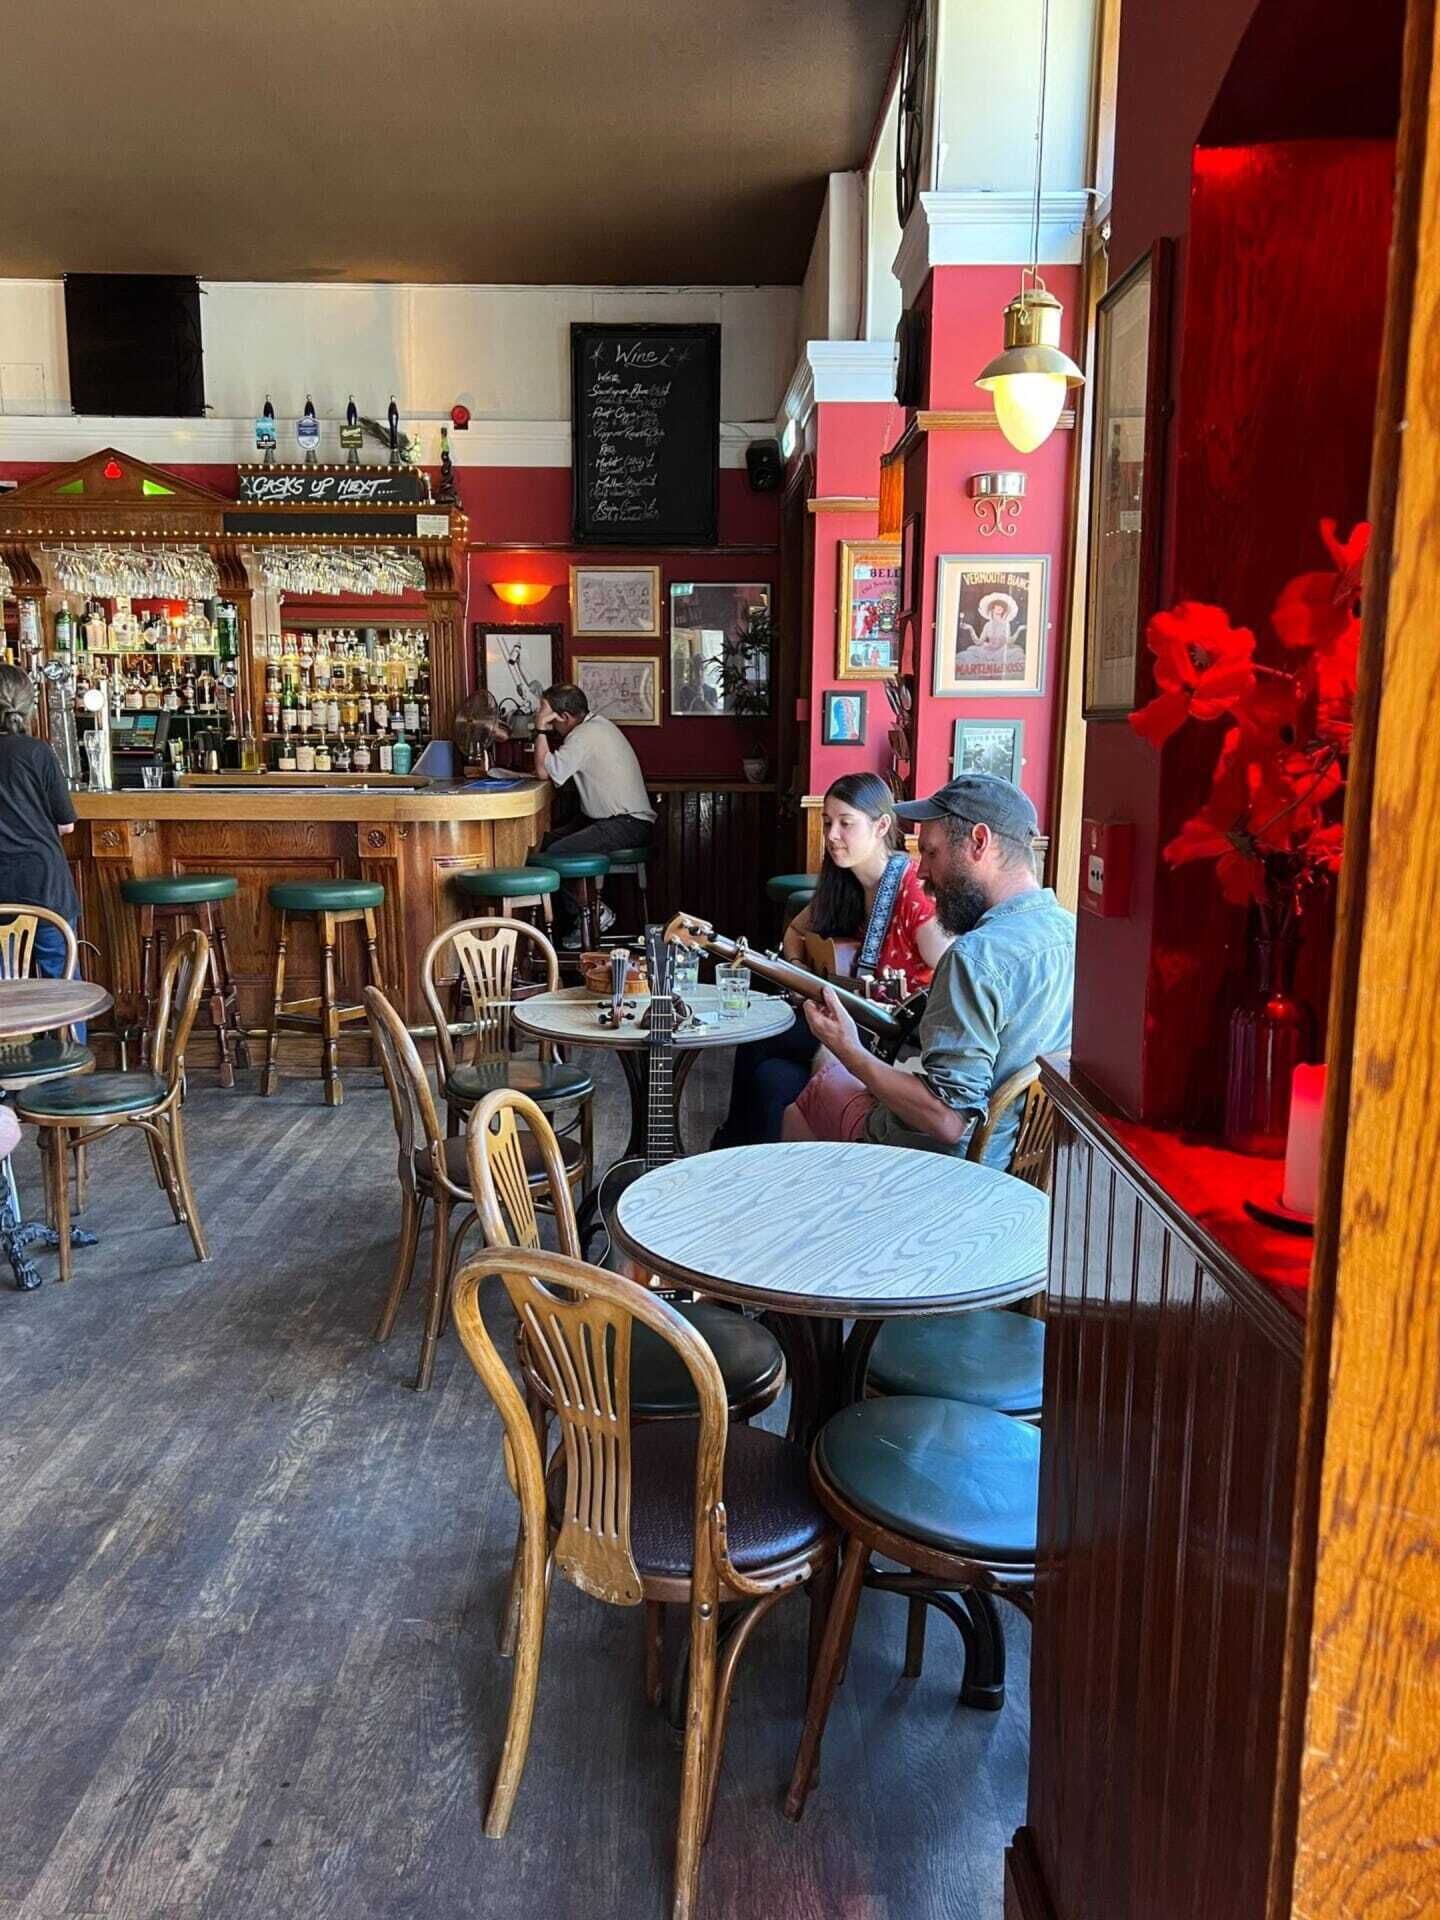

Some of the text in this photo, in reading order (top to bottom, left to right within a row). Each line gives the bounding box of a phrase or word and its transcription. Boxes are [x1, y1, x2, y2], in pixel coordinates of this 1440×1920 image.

[615, 341, 659, 364] Wine
[252, 476, 305, 497] CASKS
[310, 477, 336, 496] UP
[962, 571, 1006, 586] VERMOUTH
